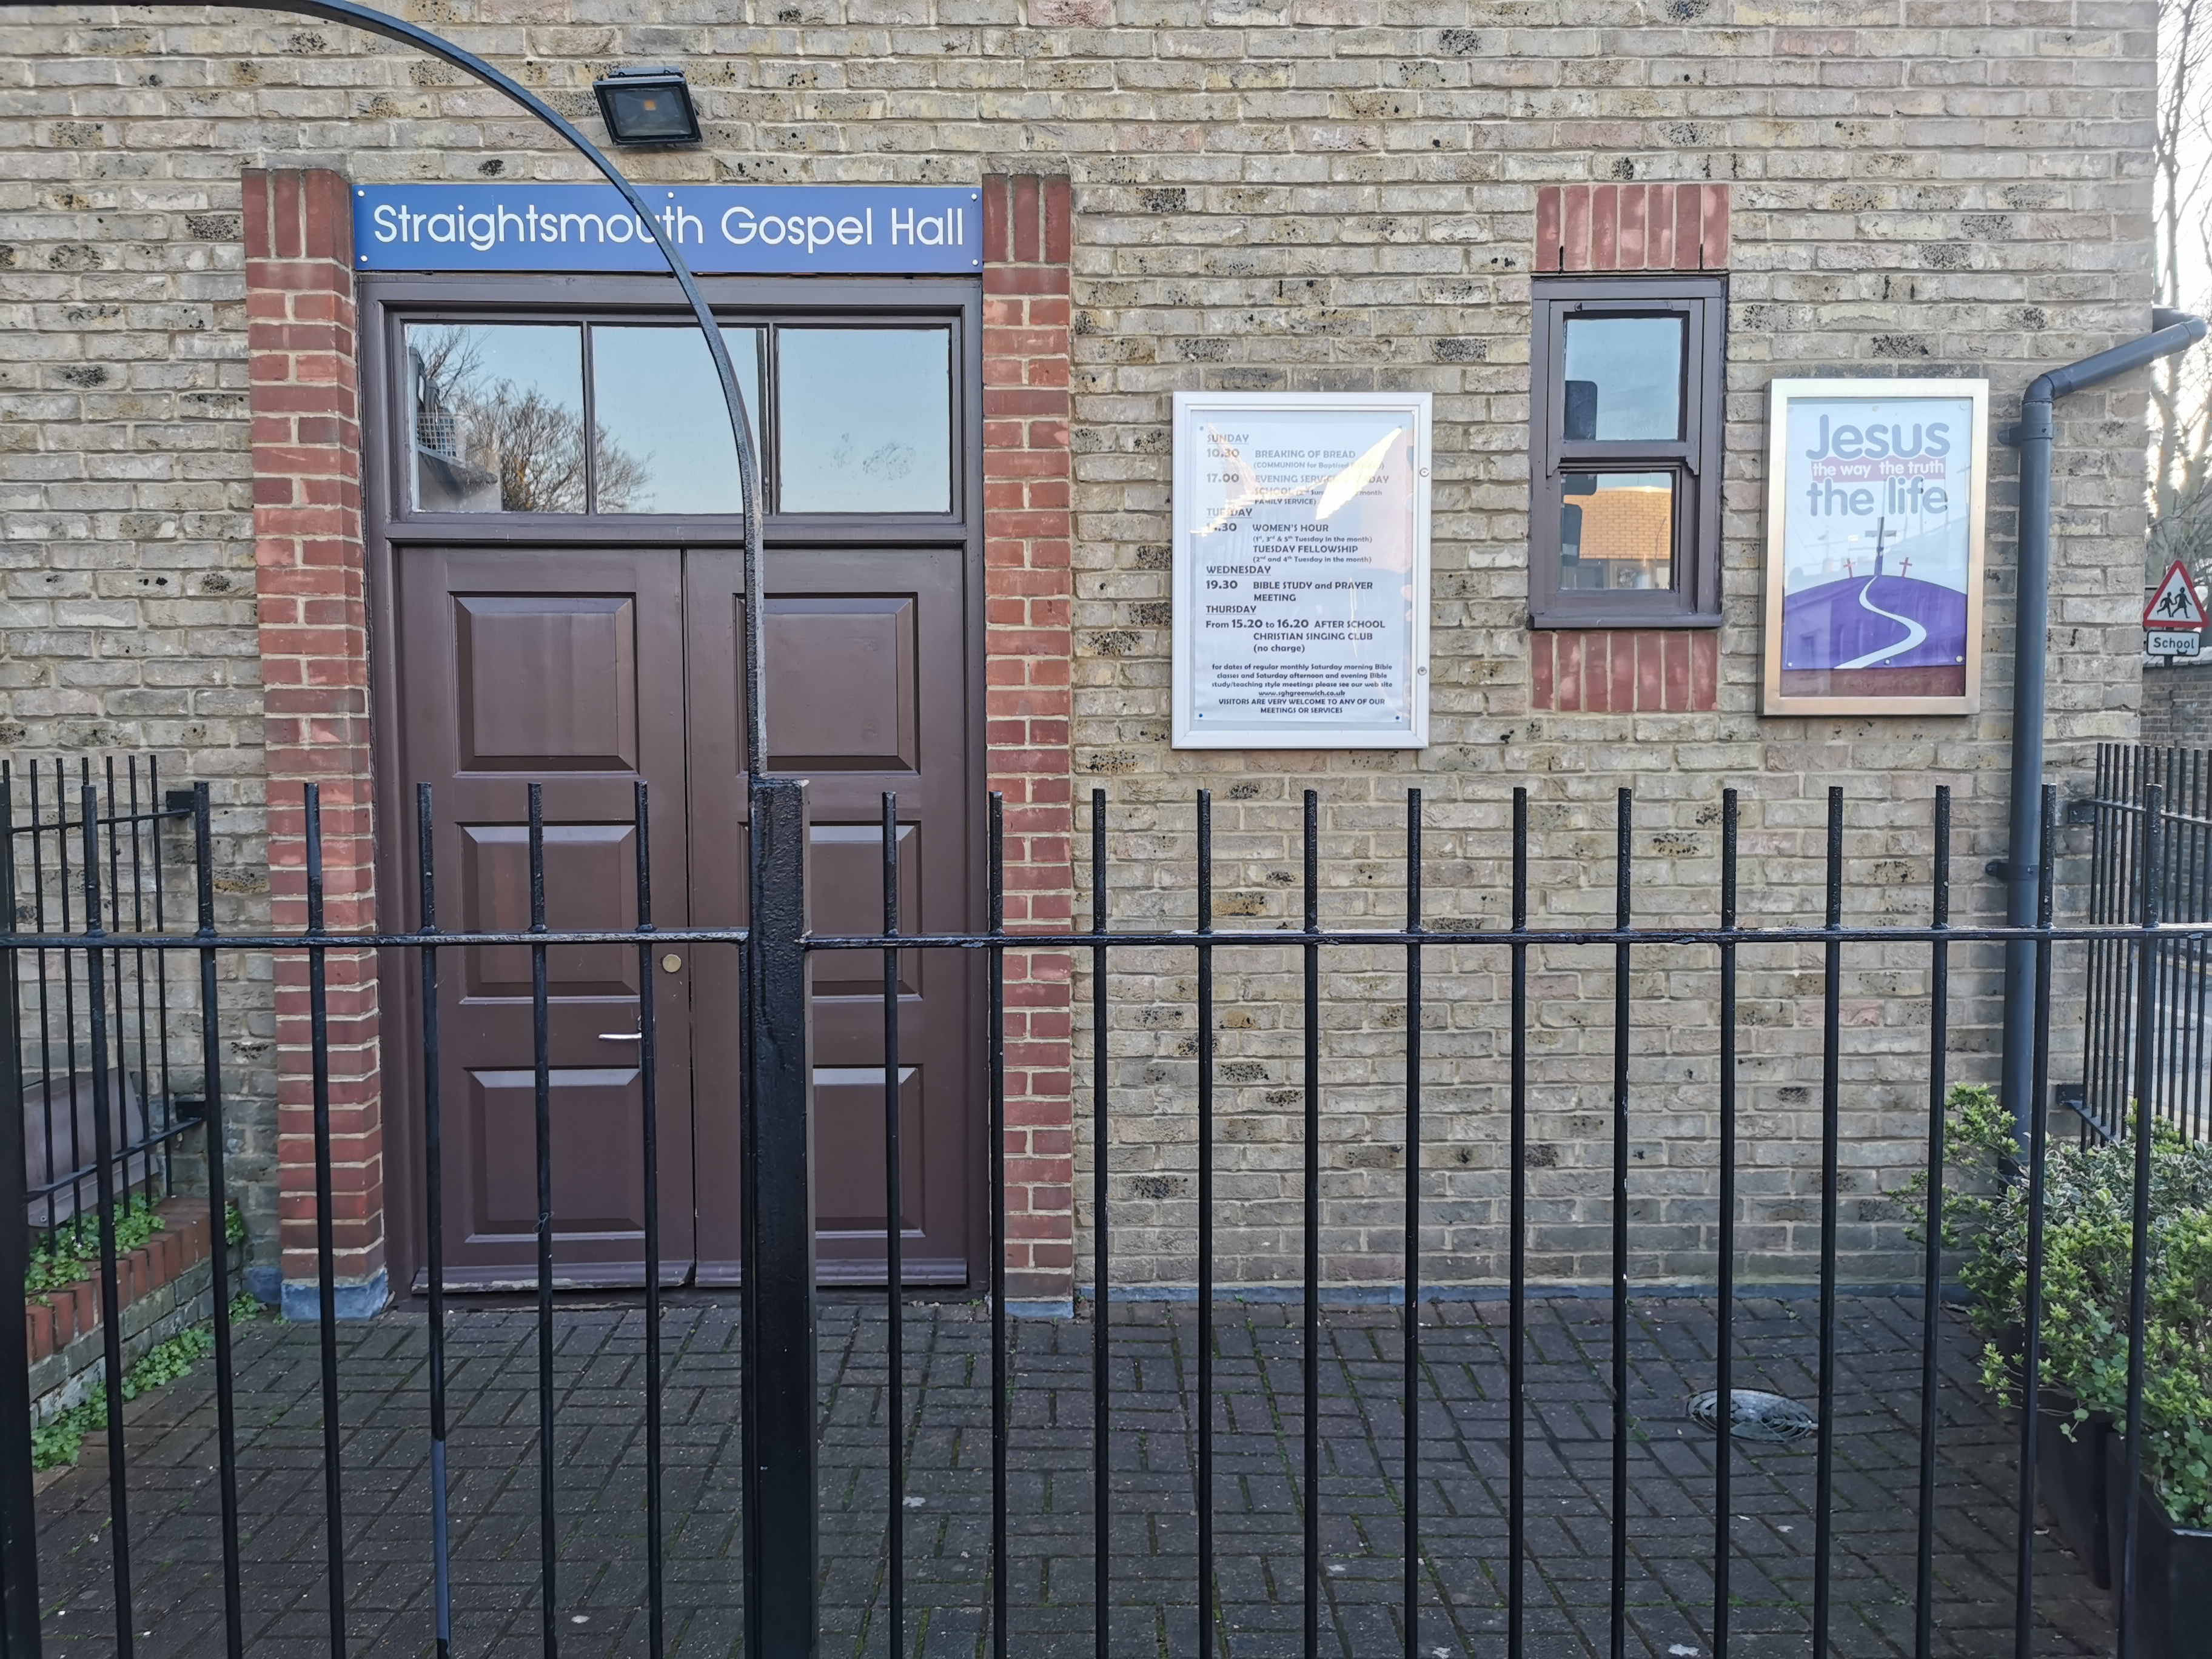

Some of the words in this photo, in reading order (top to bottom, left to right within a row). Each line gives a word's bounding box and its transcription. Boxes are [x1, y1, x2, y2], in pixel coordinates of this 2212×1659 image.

[374, 204, 703, 251] Straightsmouth
[721, 206, 873, 253] Gospel
[891, 207, 963, 245] Hall
[1207, 434, 1249, 443] SUNDAY
[1806, 414, 1951, 460] Jesus
[1207, 448, 1240, 458] 10.30
[1255, 450, 1305, 458] BREAKING
[1307, 450, 1321, 458] OF
[1323, 450, 1356, 458] BREAD
[1318, 461, 1349, 470] Baptised
[1812, 461, 1836, 476] the
[1840, 464, 1871, 478] way
[1879, 460, 1904, 474] the
[1908, 460, 1944, 474] truth
[1207, 473, 1239, 483] 17.00
[1255, 475, 1298, 483] EVENING
[1806, 478, 1874, 516] the
[1888, 476, 1948, 515] life
[1206, 580, 1238, 589] 19.30
[1232, 619, 1263, 628] 15.20
[1277, 619, 1309, 628] 16.20
[2153, 637, 2194, 649] School
[1253, 644, 1268, 653] (no
[1271, 644, 1305, 653] charge)
